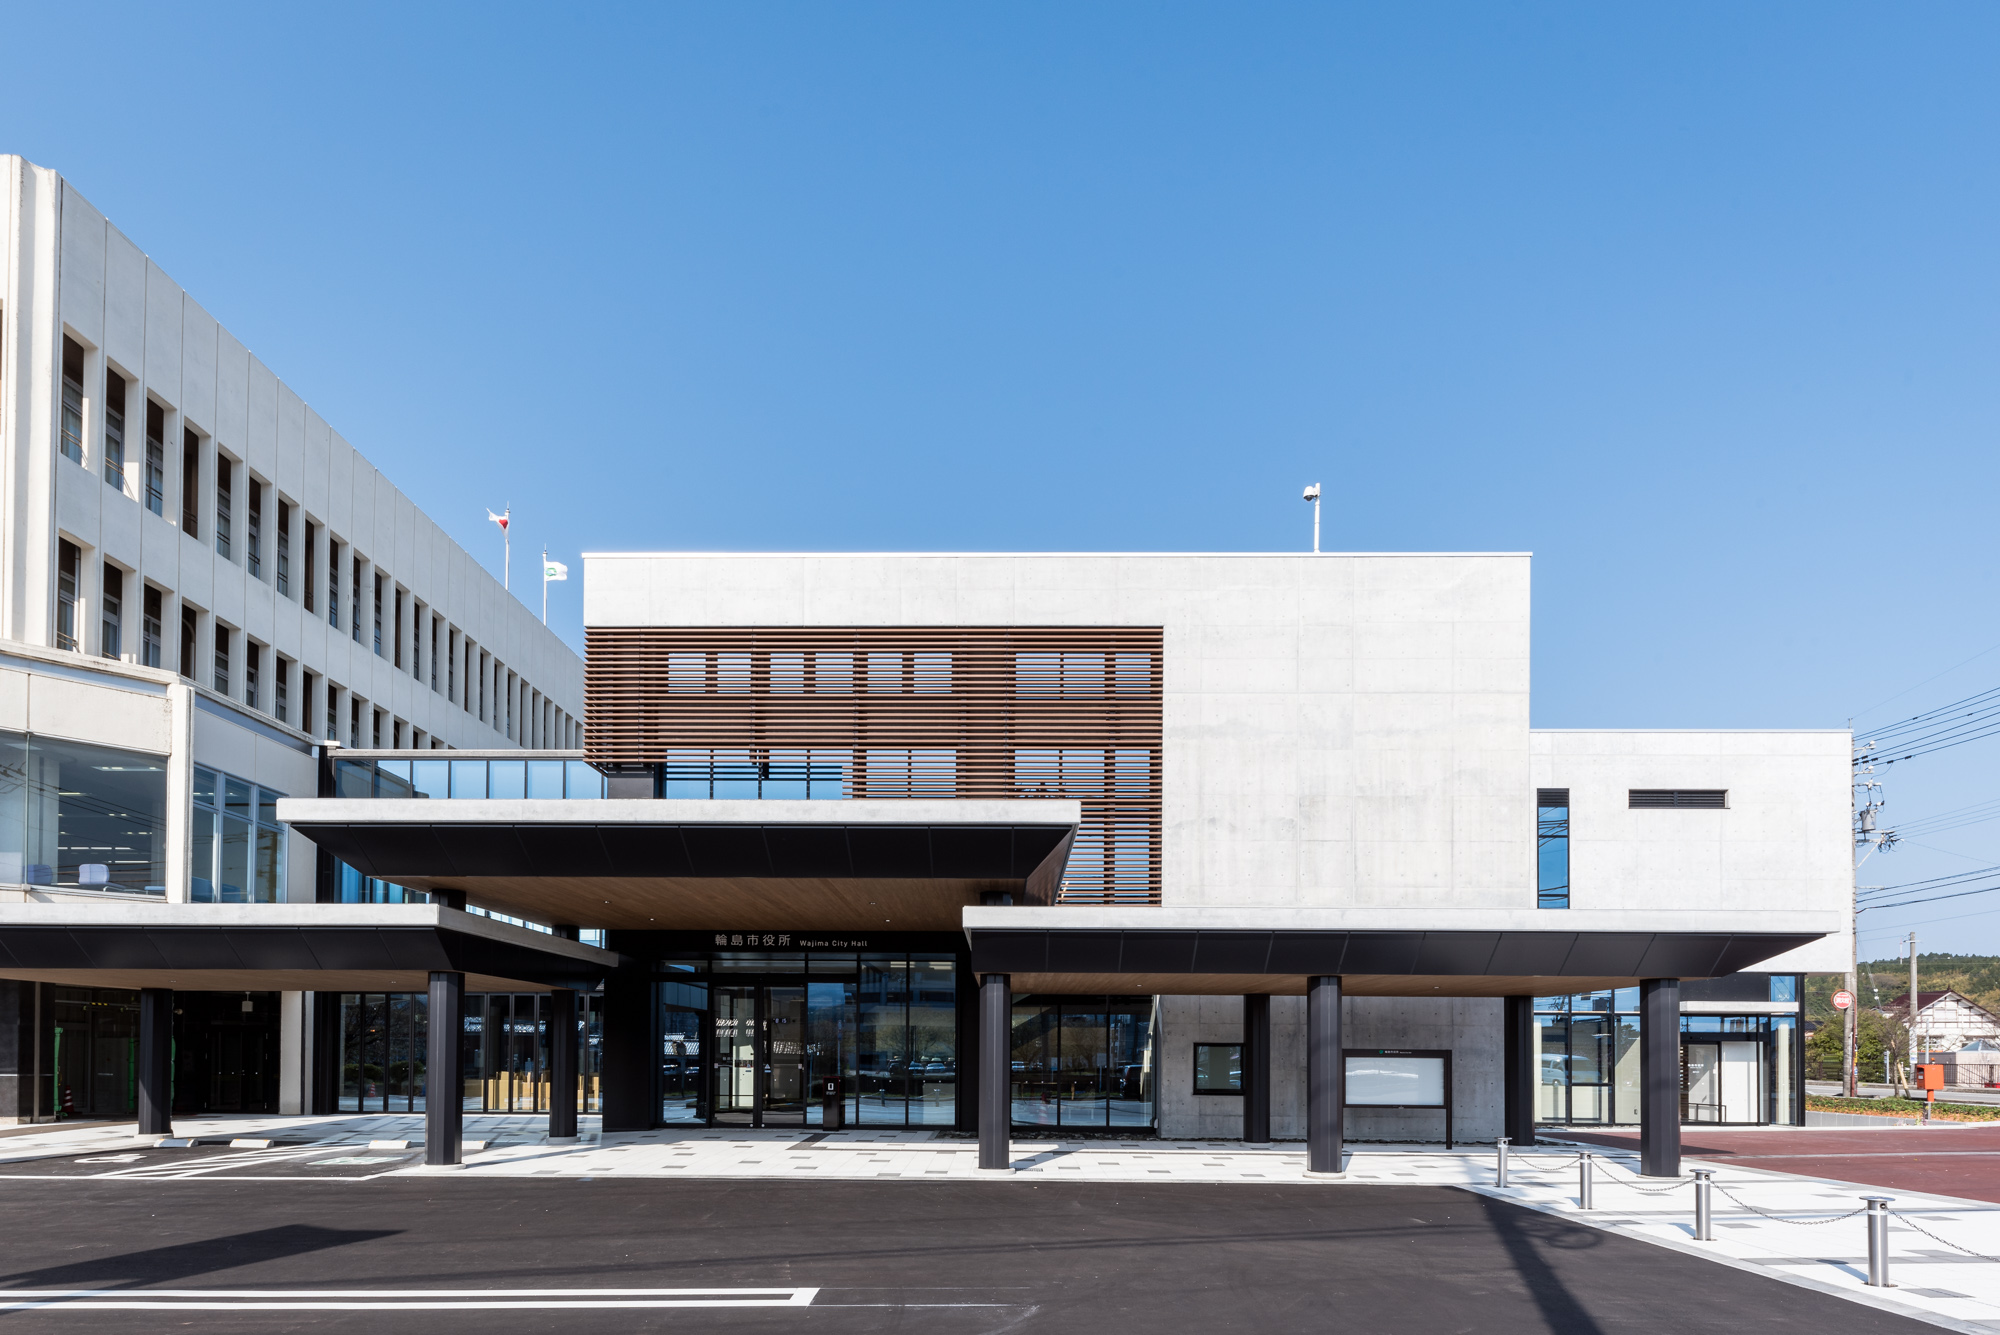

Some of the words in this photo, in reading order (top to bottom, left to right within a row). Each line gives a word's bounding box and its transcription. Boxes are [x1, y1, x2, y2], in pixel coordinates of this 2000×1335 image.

[715, 934, 791, 946] 輪島市役所
[800, 940, 829, 948] Wajima
[831, 940, 848, 948] City
